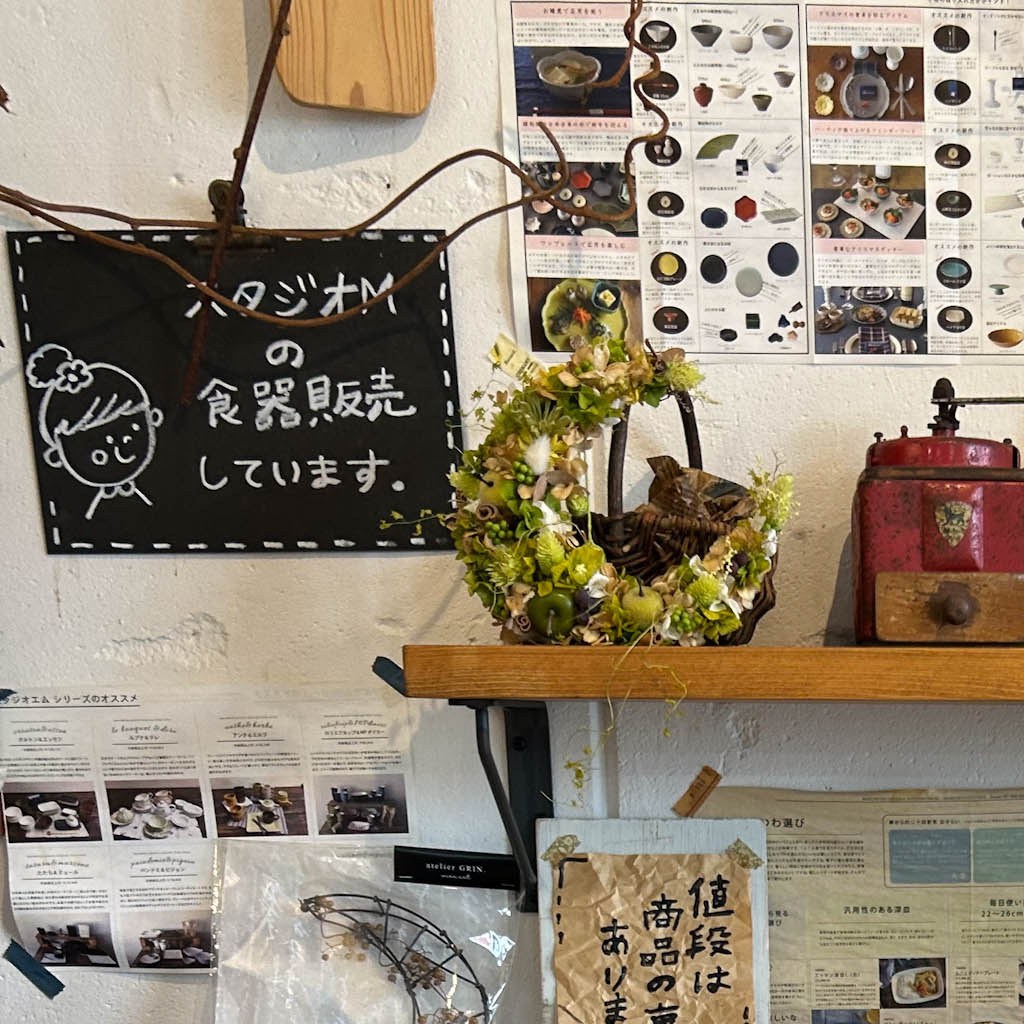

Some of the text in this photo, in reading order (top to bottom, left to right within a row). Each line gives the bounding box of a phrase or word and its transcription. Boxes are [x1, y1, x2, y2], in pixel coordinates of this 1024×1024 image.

[265, 339, 305, 368] の
[198, 367, 418, 431] 食器販売
[200, 449, 406, 493] しています。
[425, 863, 456, 871] atelier
[686, 874, 735, 994] 値段は
